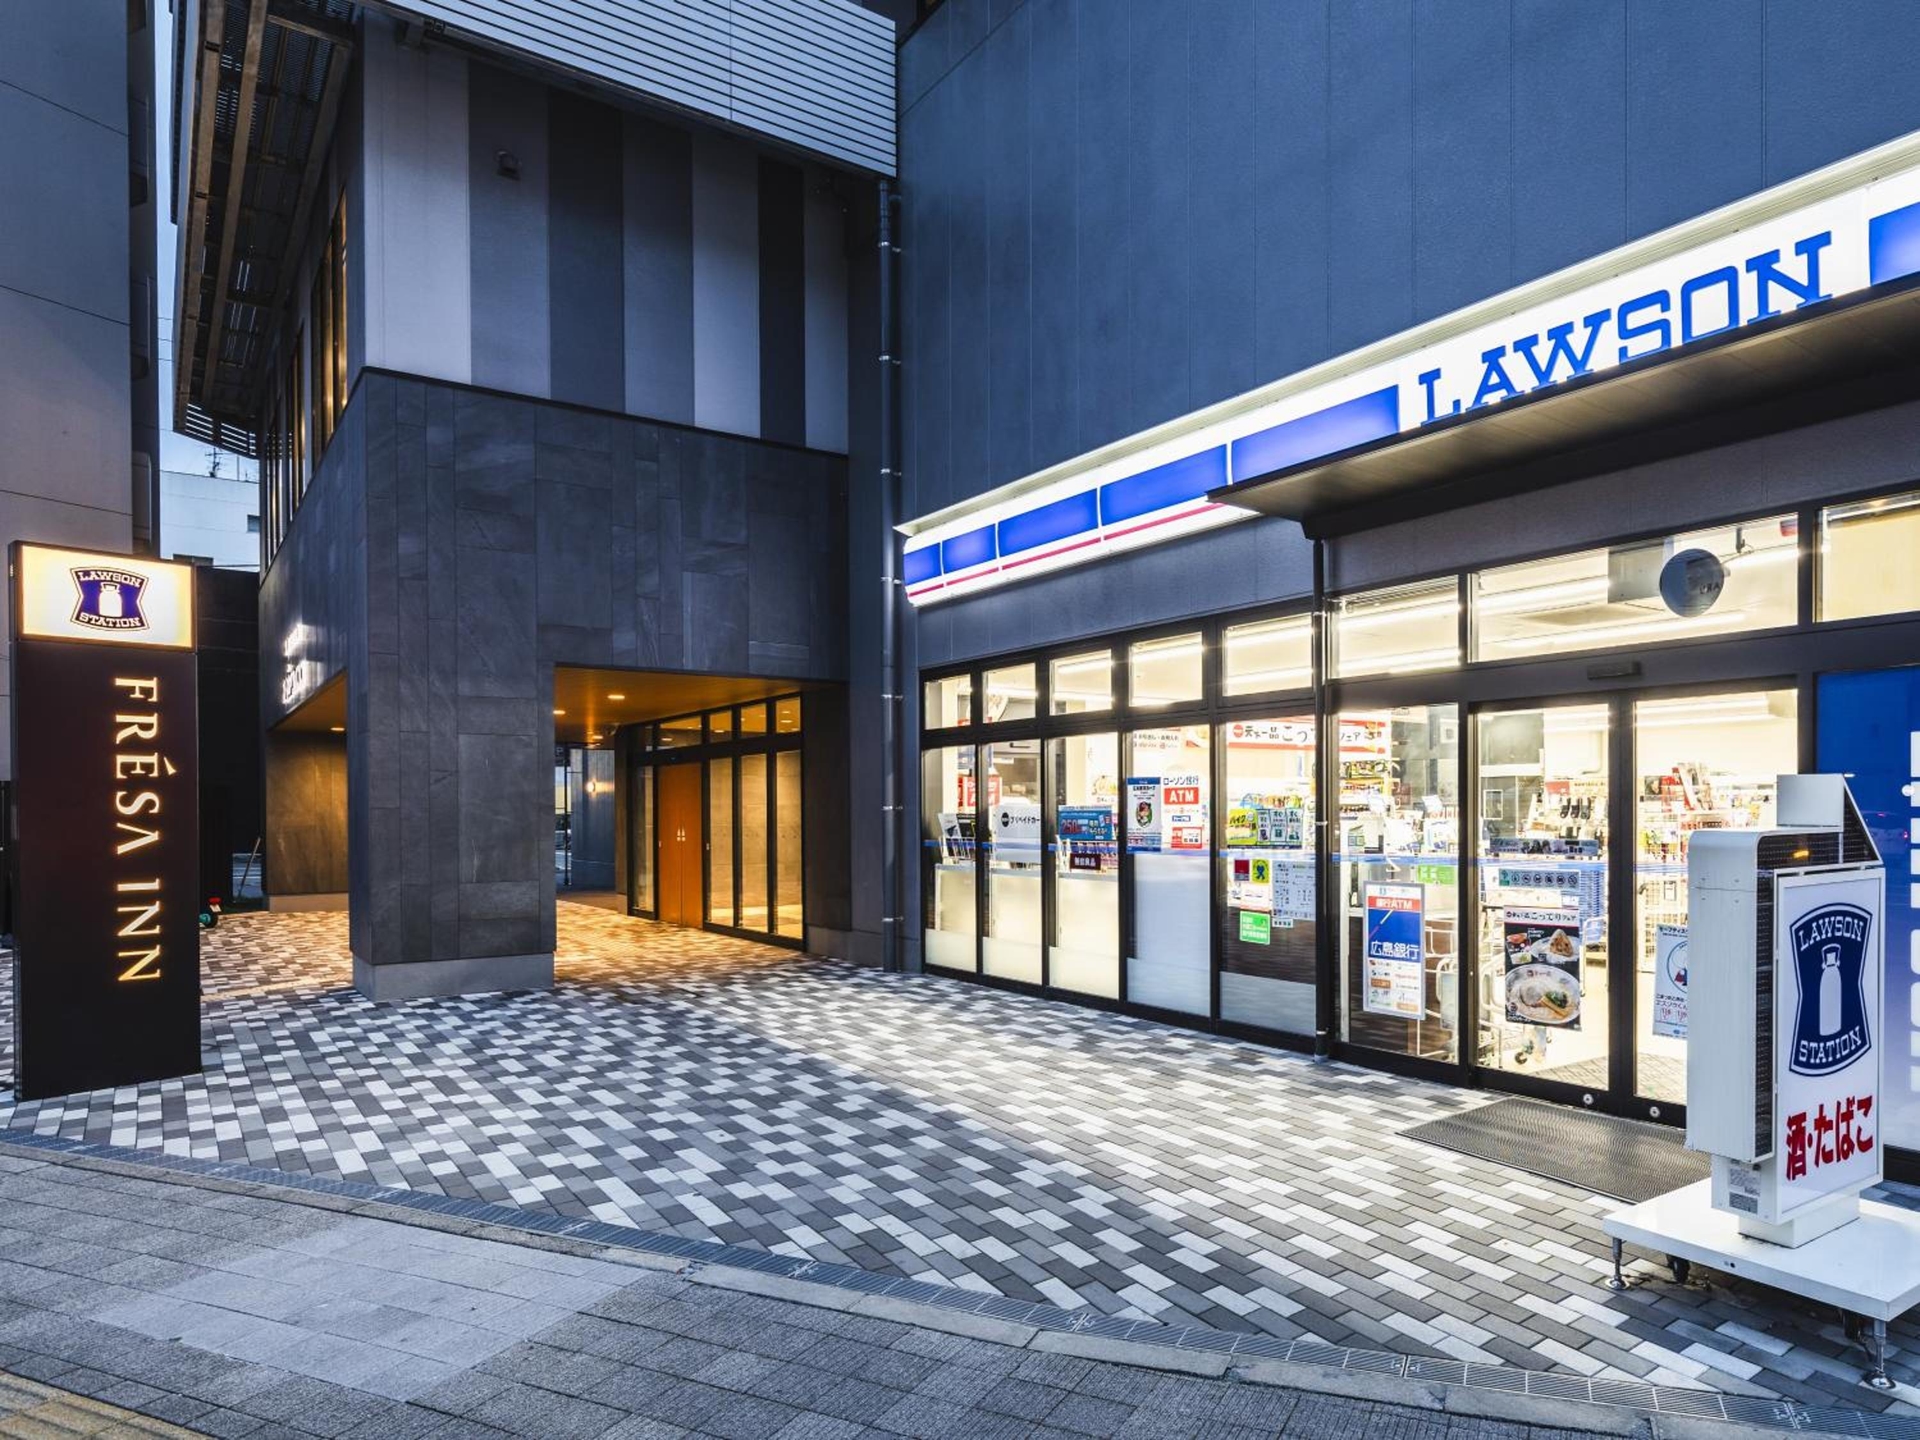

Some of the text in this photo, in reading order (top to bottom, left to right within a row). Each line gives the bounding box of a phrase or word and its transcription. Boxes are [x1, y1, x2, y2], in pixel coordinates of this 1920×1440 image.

[1418, 231, 1833, 427] LAWSON
[78, 571, 142, 588] LAWSON
[79, 612, 141, 627] STATION
[1169, 789, 1195, 803] ATM
[116, 878, 161, 983] INN
[1799, 916, 1864, 951] LAWSON
[1371, 940, 1419, 960] 広島銀行
[1799, 1026, 1862, 1064] STATION
[1786, 1095, 1873, 1182] 酒・たばこ
